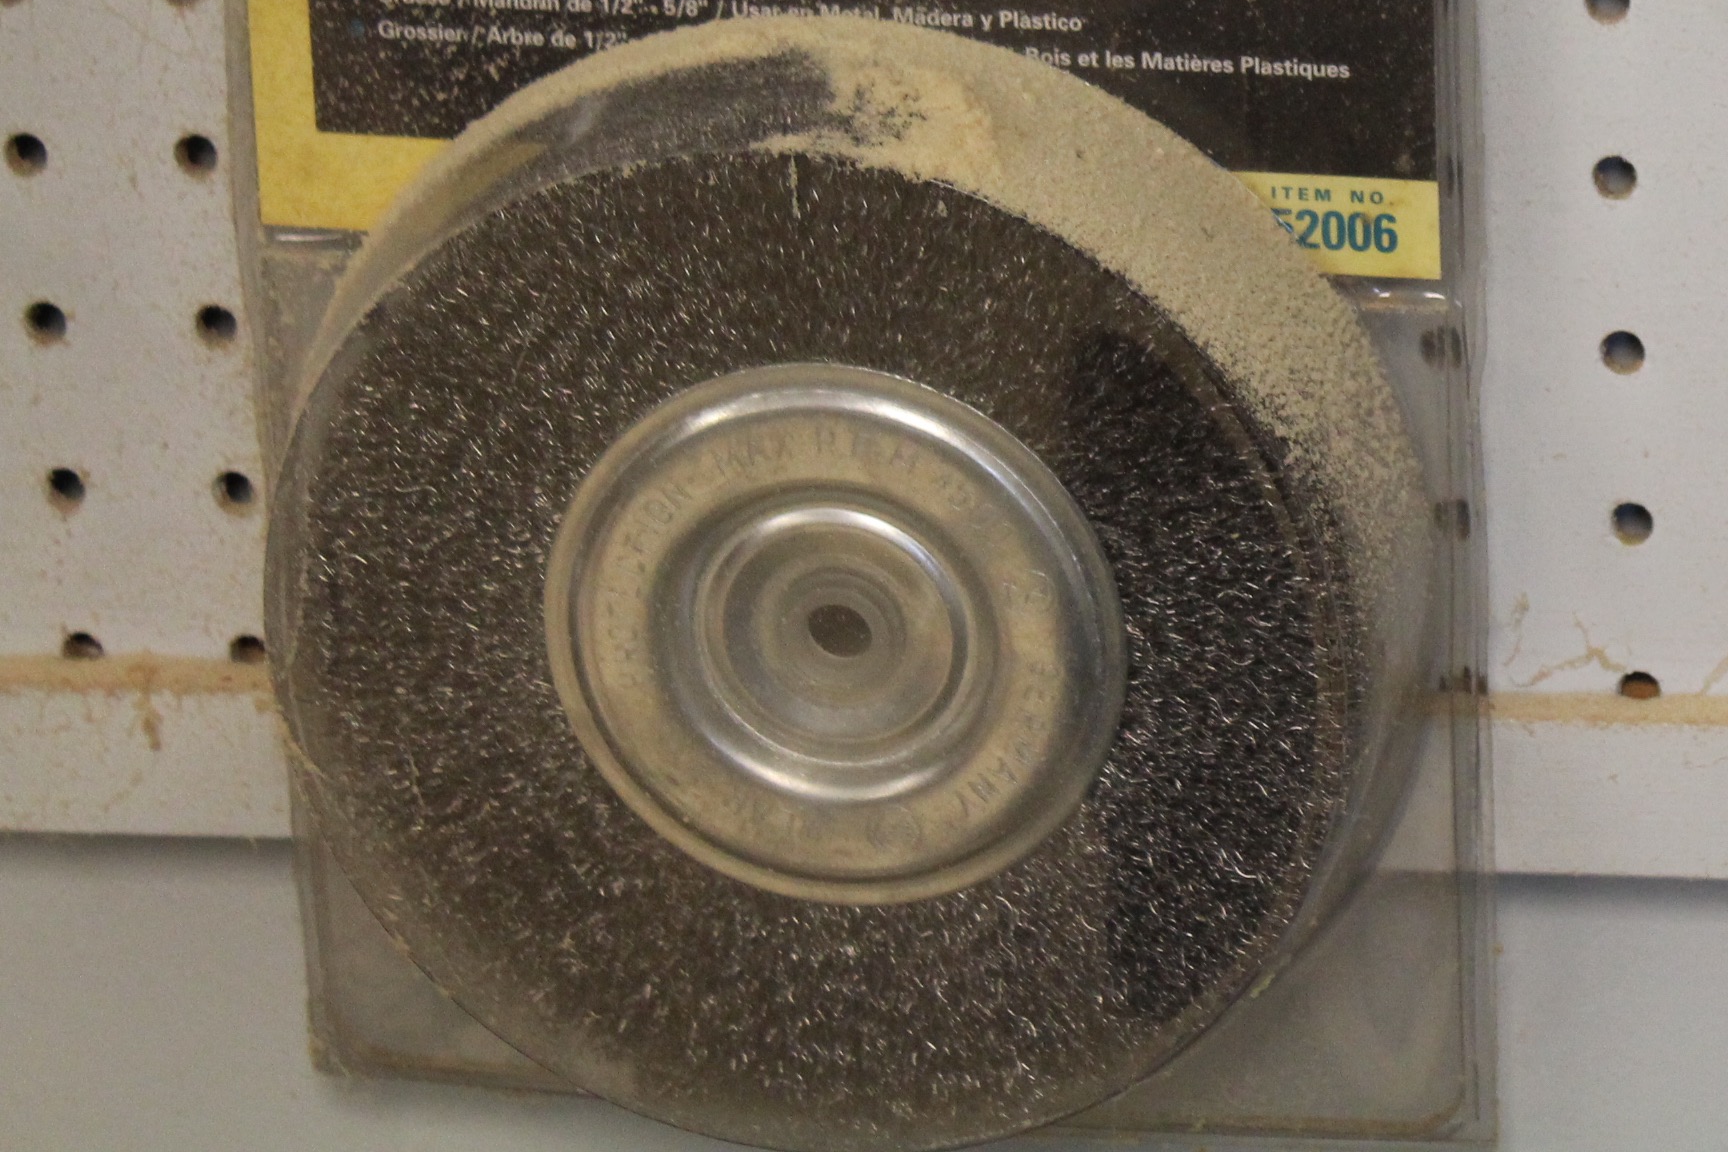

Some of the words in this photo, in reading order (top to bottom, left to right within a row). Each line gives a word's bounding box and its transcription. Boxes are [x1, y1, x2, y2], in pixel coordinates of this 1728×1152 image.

[893, 6, 974, 28] Madera
[980, 14, 993, 32] y
[378, 19, 466, 43] Grossier
[487, 26, 545, 47] Arbre
[551, 29, 577, 48] de
[1078, 51, 1100, 68] et
[1105, 50, 1136, 69] les
[1141, 51, 1234, 75] Matières
[1240, 55, 1351, 80] Plastiques
[1271, 186, 1332, 202] ITEM
